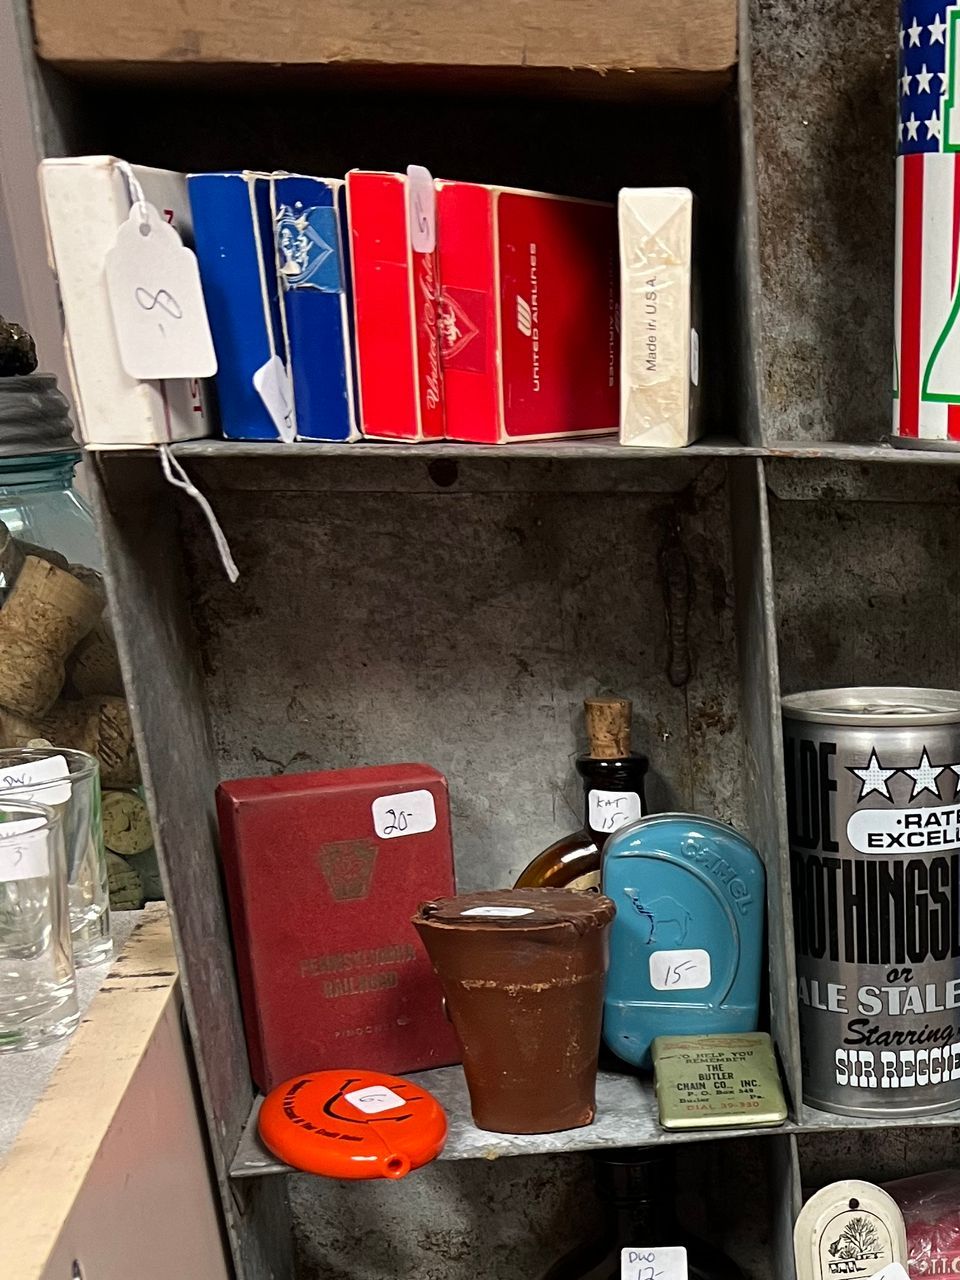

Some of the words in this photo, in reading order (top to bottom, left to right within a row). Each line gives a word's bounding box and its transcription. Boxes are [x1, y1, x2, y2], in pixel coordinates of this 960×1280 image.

[532, 243, 541, 324] AIRLINES
[645, 275, 658, 317] U.S.A.
[646, 318, 657, 332] in
[532, 329, 541, 392] UNITED
[645, 335, 656, 372] Made
[596, 796, 627, 811] KAT
[323, 970, 399, 999] RAILROAD
[664, 963, 697, 988] 15-
[886, 967, 914, 984] or
[799, 976, 849, 1014] ALE
[843, 1018, 956, 1047] Starring
[698, 1072, 735, 1081] BUTLER
[705, 1063, 725, 1072] THE
[834, 1048, 878, 1089] SIR
[676, 1082, 707, 1091] CHAIN
[740, 1079, 762, 1088] INC.
